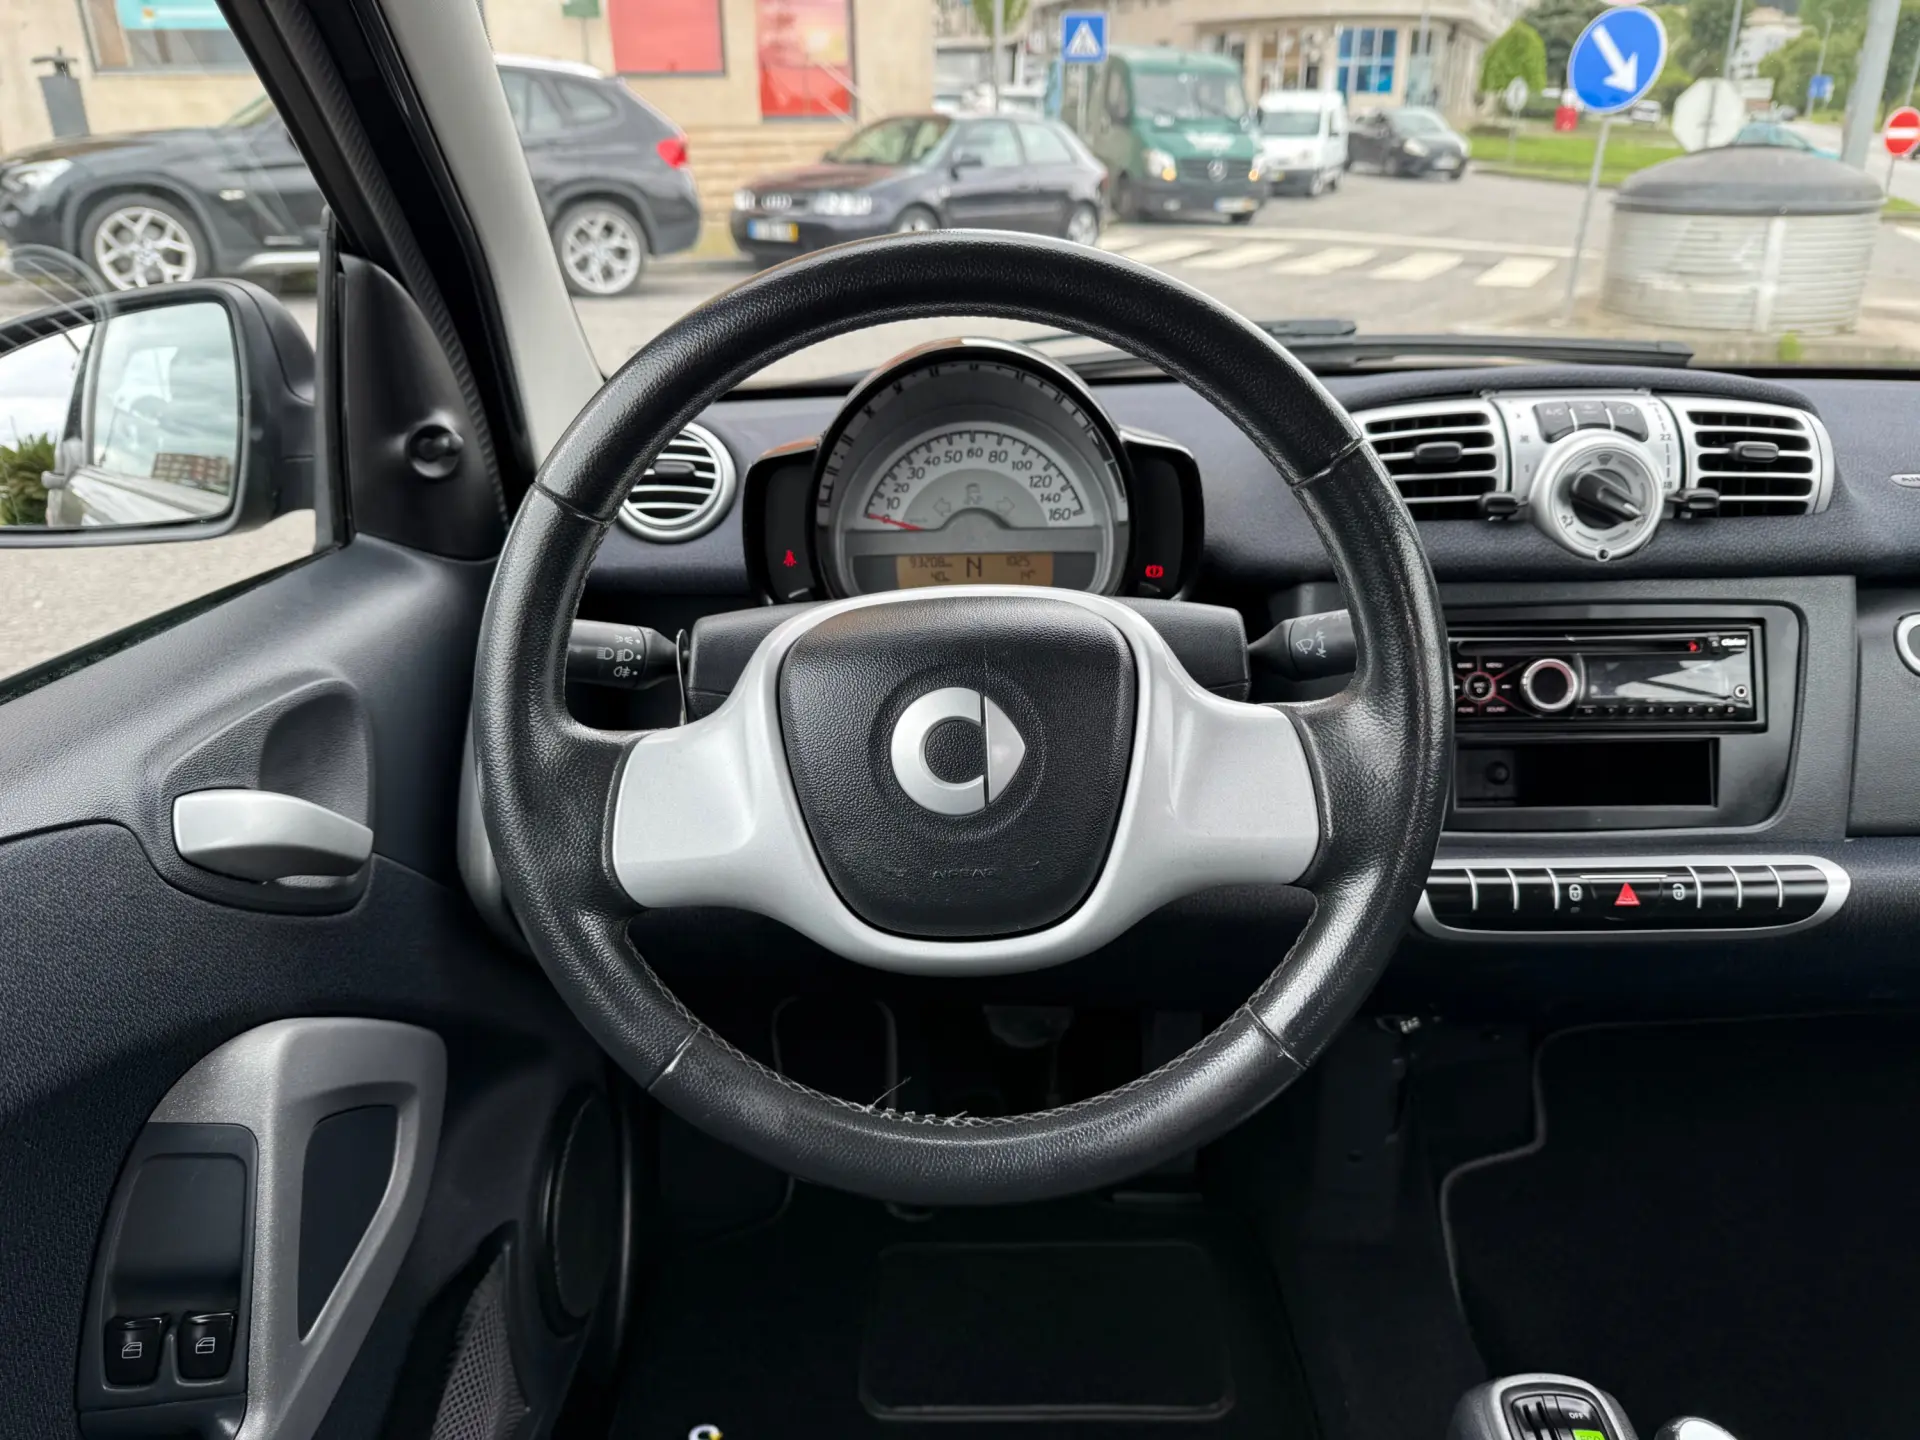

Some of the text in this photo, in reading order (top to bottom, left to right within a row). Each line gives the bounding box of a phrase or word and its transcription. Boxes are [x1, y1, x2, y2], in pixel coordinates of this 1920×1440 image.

[1660, 433, 1672, 441] 22
[943, 450, 963, 463] 50
[966, 447, 983, 458] 60
[988, 450, 1008, 463] 80
[924, 456, 941, 466] 40
[1011, 460, 1033, 471] 100
[907, 467, 925, 480] 30
[1029, 475, 1052, 488] 120
[893, 483, 910, 493] 20
[886, 496, 900, 510] 10
[1040, 493, 1061, 503] 140
[1048, 508, 1071, 521] 160
[966, 556, 983, 578] N
[1568, 1411, 1583, 1420] OFF
